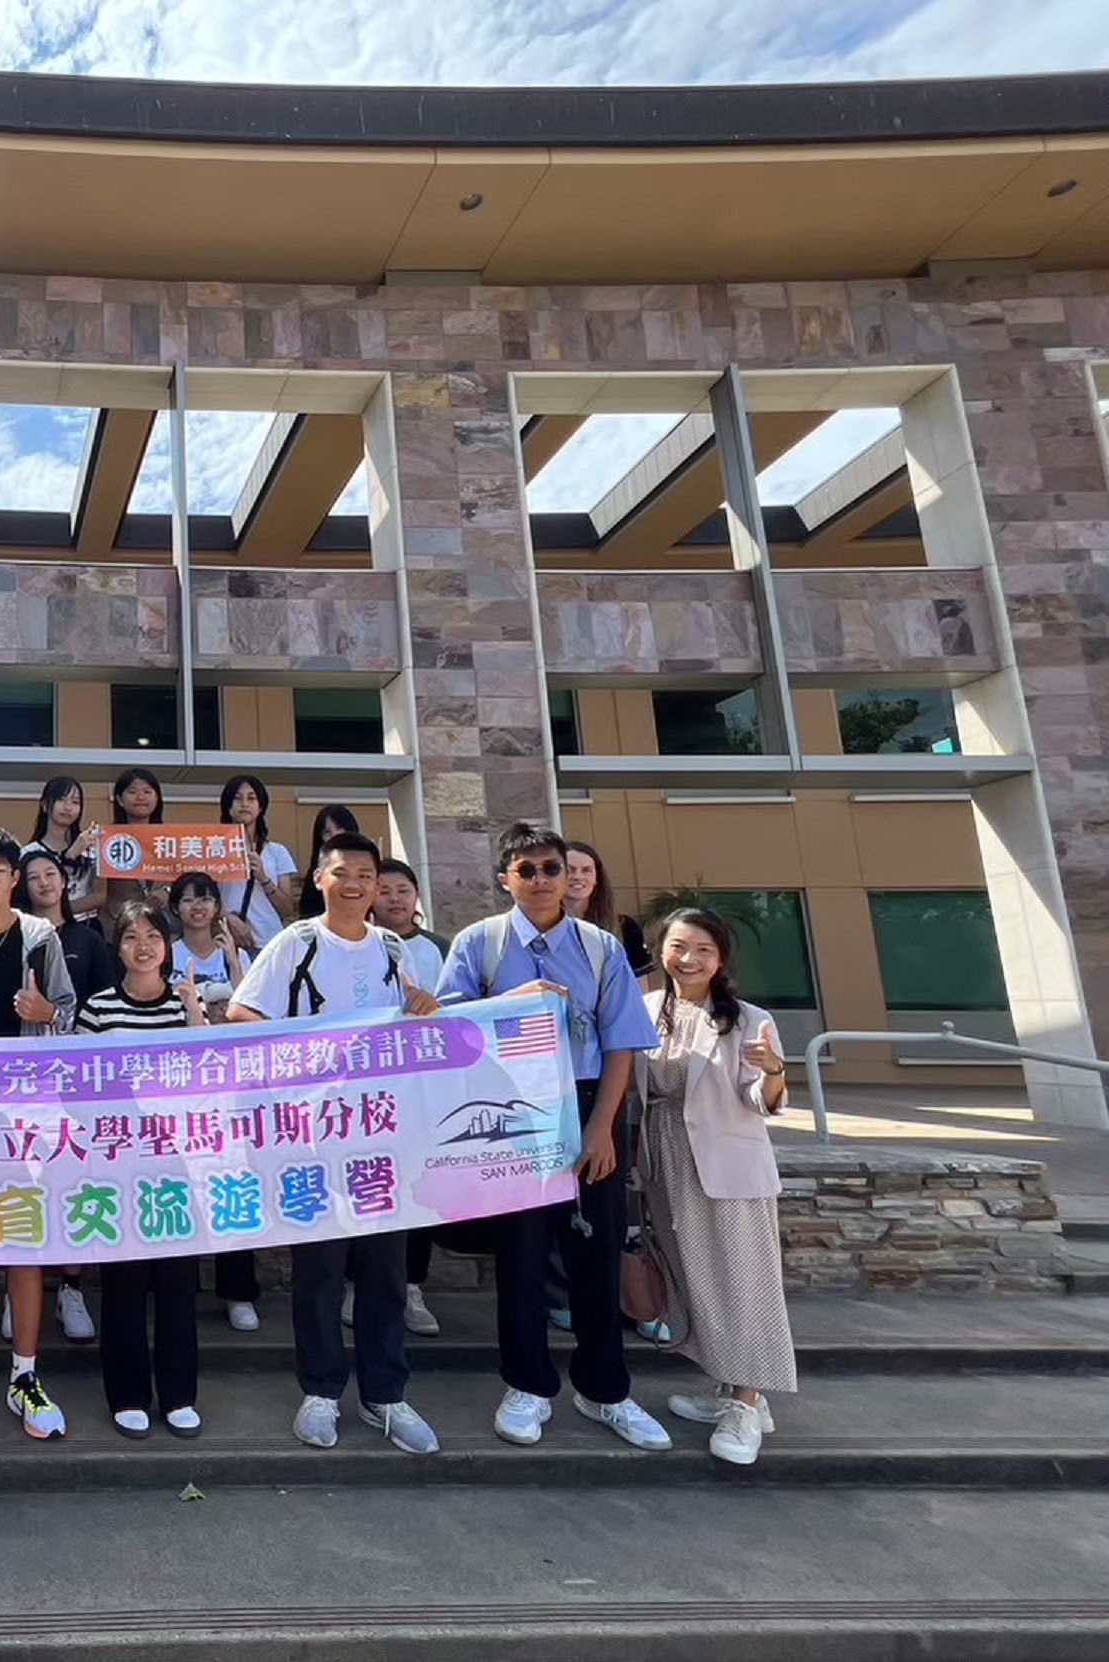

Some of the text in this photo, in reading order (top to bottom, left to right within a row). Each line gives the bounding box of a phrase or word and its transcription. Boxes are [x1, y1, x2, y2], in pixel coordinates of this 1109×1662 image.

[153, 835, 246, 859] 和美高中
[207, 863, 228, 874] High
[424, 1154, 479, 1169] California
[480, 1150, 514, 1163] State
[480, 1157, 564, 1181] SAN MARCOS
